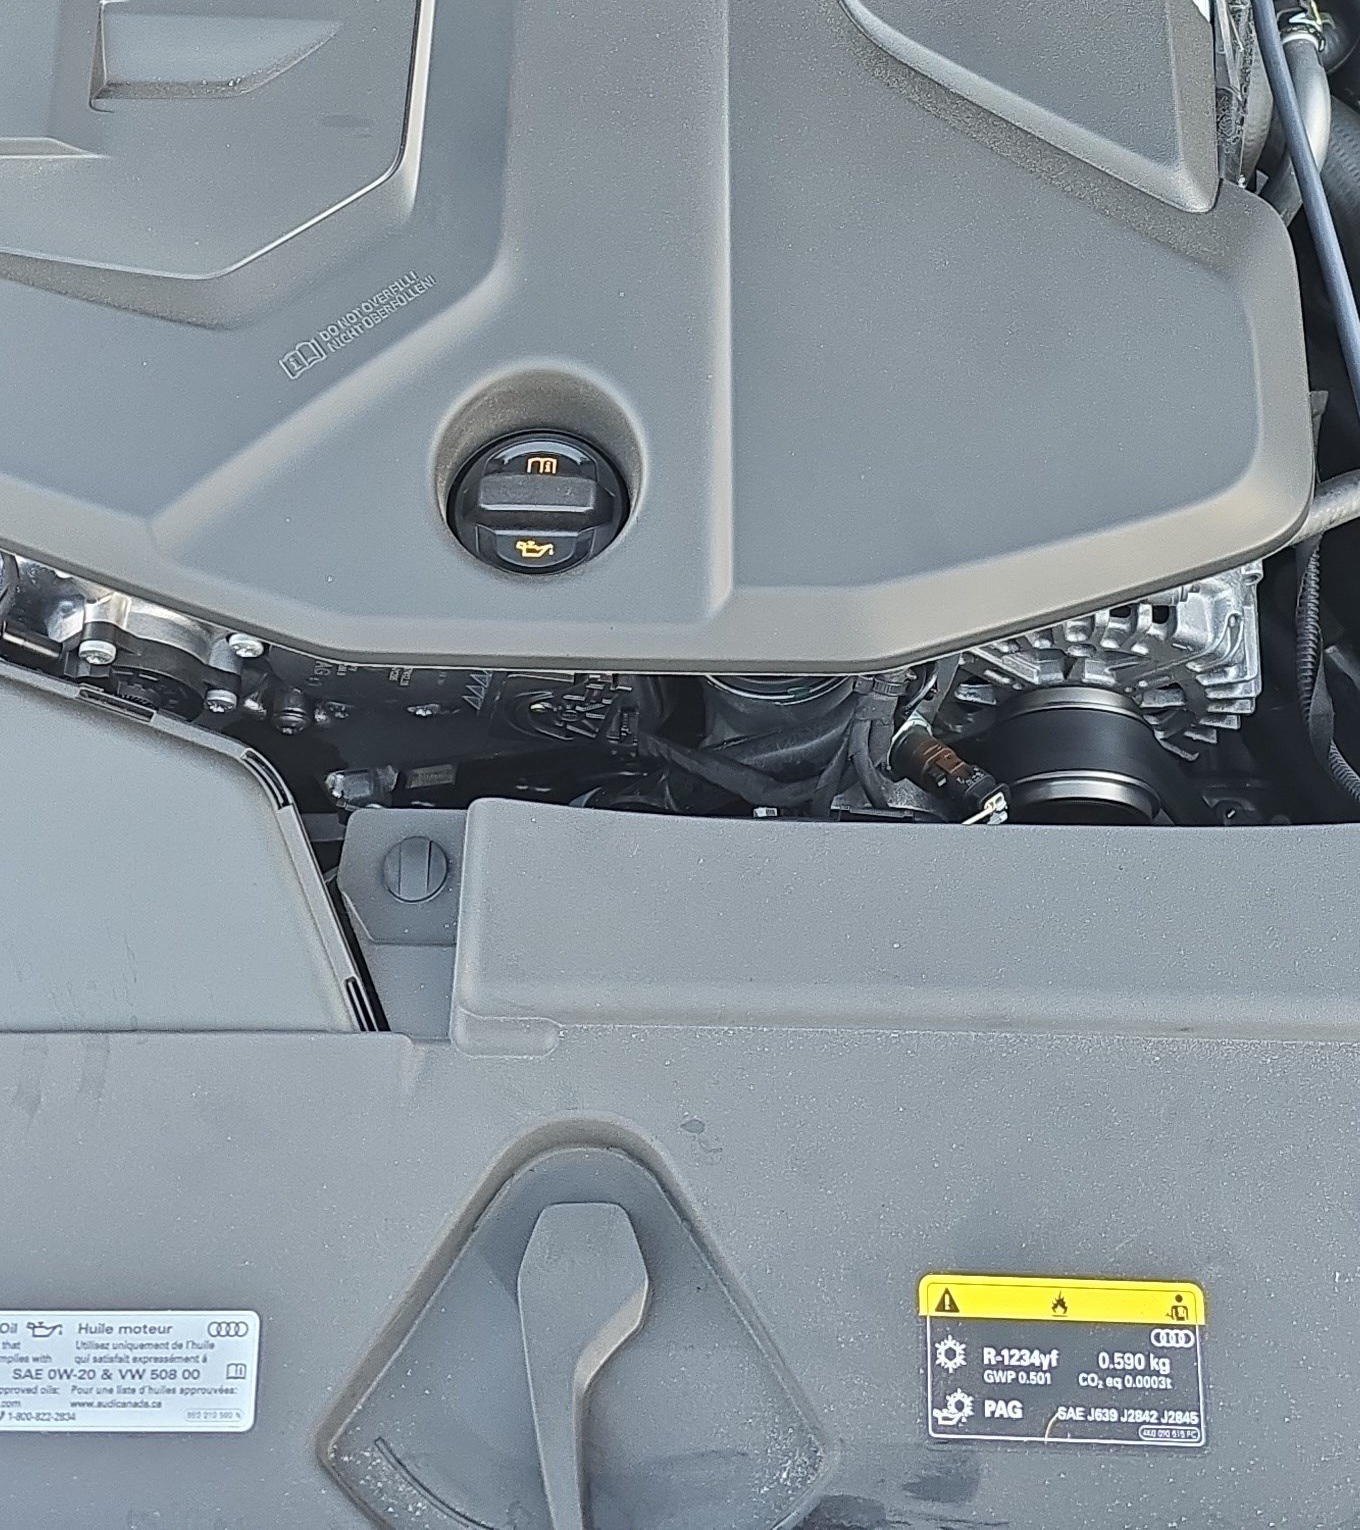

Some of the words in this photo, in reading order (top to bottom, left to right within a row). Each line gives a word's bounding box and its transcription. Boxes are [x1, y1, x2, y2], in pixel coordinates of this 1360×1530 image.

[319, 323, 339, 341] DO
[337, 307, 363, 330] NOT
[327, 323, 364, 352] NICHT
[0, 1322, 18, 1334] Oil
[78, 1323, 114, 1335] Huile
[118, 1324, 173, 1335] moteur
[2, 1340, 21, 1350] that
[75, 1340, 110, 1350] Utilisez
[112, 1341, 169, 1352] uniquement
[172, 1340, 183, 1350] de
[32, 1354, 52, 1363] with
[74, 1354, 90, 1366] qui
[93, 1354, 130, 1364] satisfait
[983, 1347, 1059, 1370] R-1234yf
[1098, 1352, 1145, 1370] 0.590
[1150, 1353, 1171, 1374] kg
[12, 1369, 43, 1380] SAE
[47, 1369, 96, 1380] 0W-20
[101, 1369, 113, 1380] &
[118, 1369, 146, 1380] VW
[150, 1369, 177, 1380] 508
[182, 1369, 201, 1380] 00
[984, 1370, 1016, 1384] GWP
[1018, 1372, 1052, 1385] 0.501
[1106, 1377, 1123, 1390] eq
[71, 1385, 93, 1395] Pour
[96, 1387, 114, 1395] une
[117, 1385, 136, 1395] liste
[984, 1400, 1023, 1418] PAG
[1057, 1407, 1085, 1421] SAE
[1087, 1408, 1118, 1421] J639
[1120, 1409, 1158, 1423] J2842
[1160, 1410, 1200, 1424] J2845
